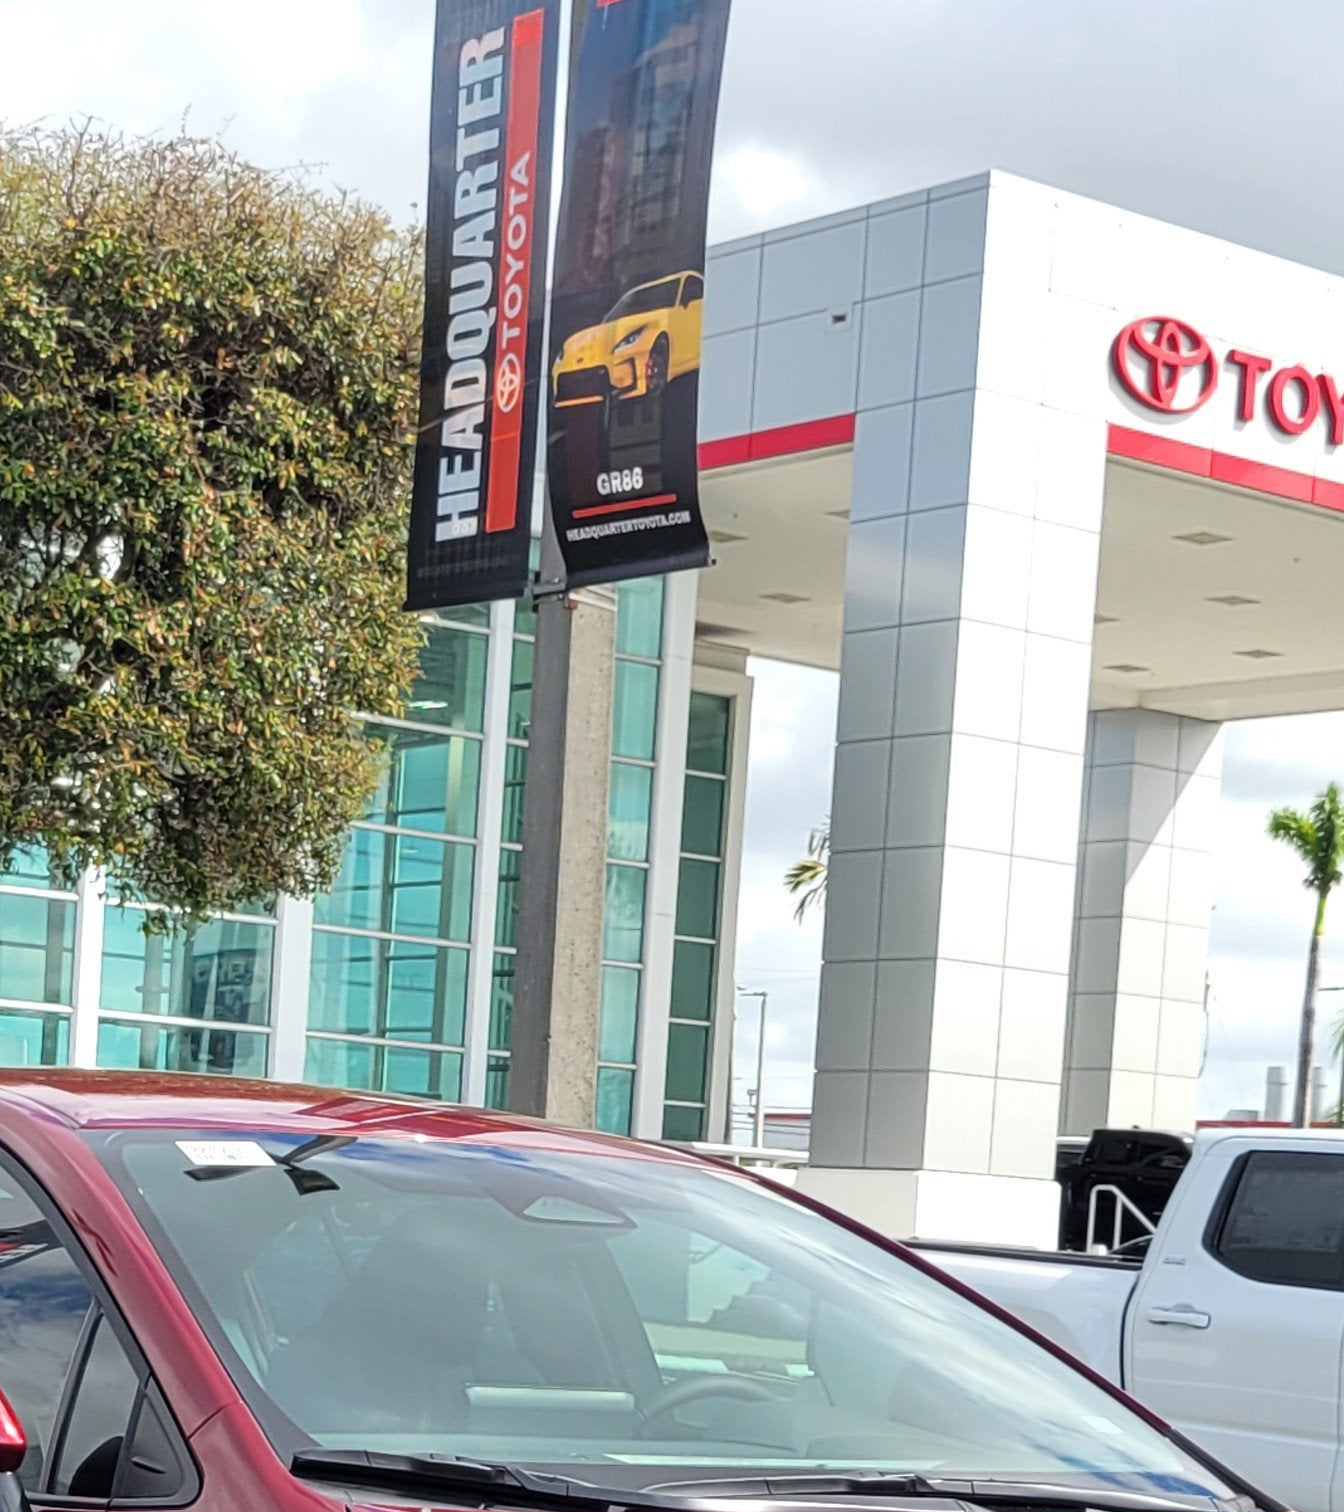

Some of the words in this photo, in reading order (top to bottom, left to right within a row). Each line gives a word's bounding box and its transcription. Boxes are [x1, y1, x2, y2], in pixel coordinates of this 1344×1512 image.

[436, 27, 506, 542] HEADQUARTER
[501, 152, 531, 350] TOYOTA
[597, 467, 644, 496] GR86
